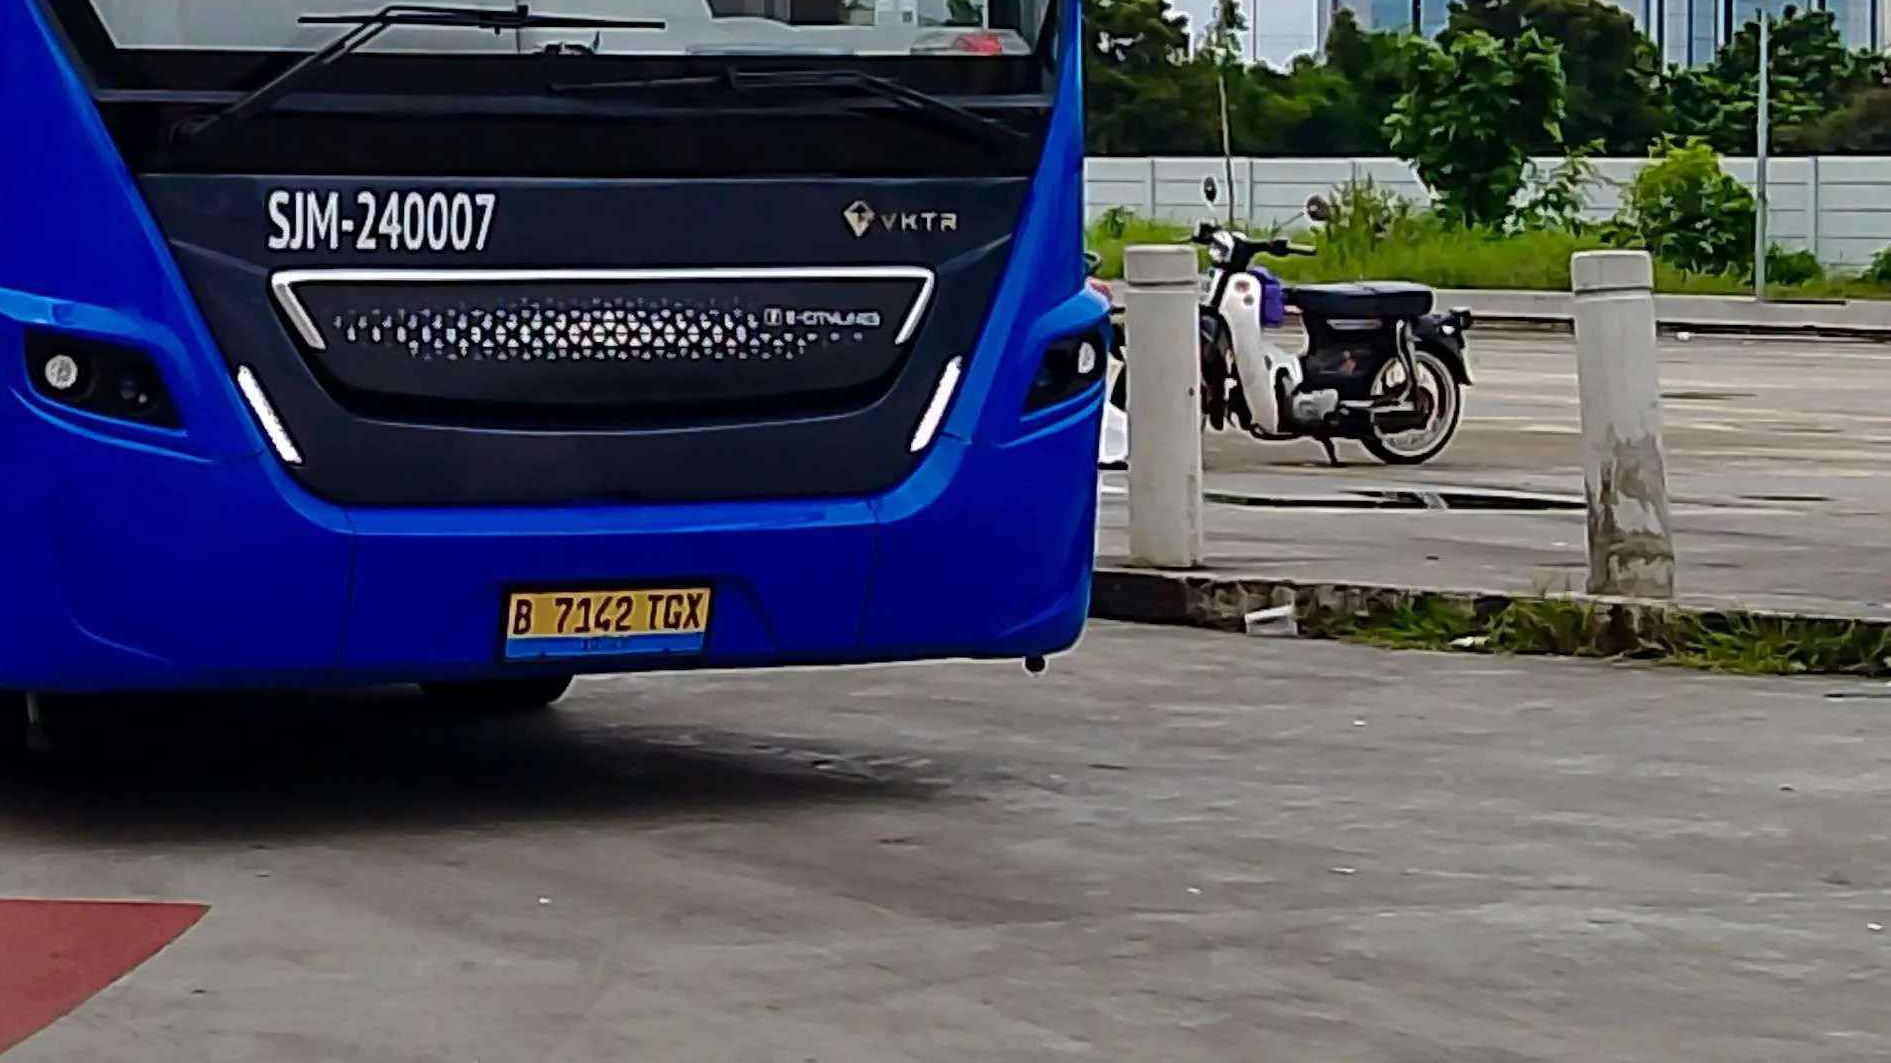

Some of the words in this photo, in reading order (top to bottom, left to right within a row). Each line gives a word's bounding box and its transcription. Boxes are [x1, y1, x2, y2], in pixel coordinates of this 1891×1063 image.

[267, 190, 497, 250] SJM-240007
[880, 211, 957, 231] VKTR
[513, 598, 533, 634] B
[555, 596, 634, 633] 7142
[648, 593, 703, 630] TGX
